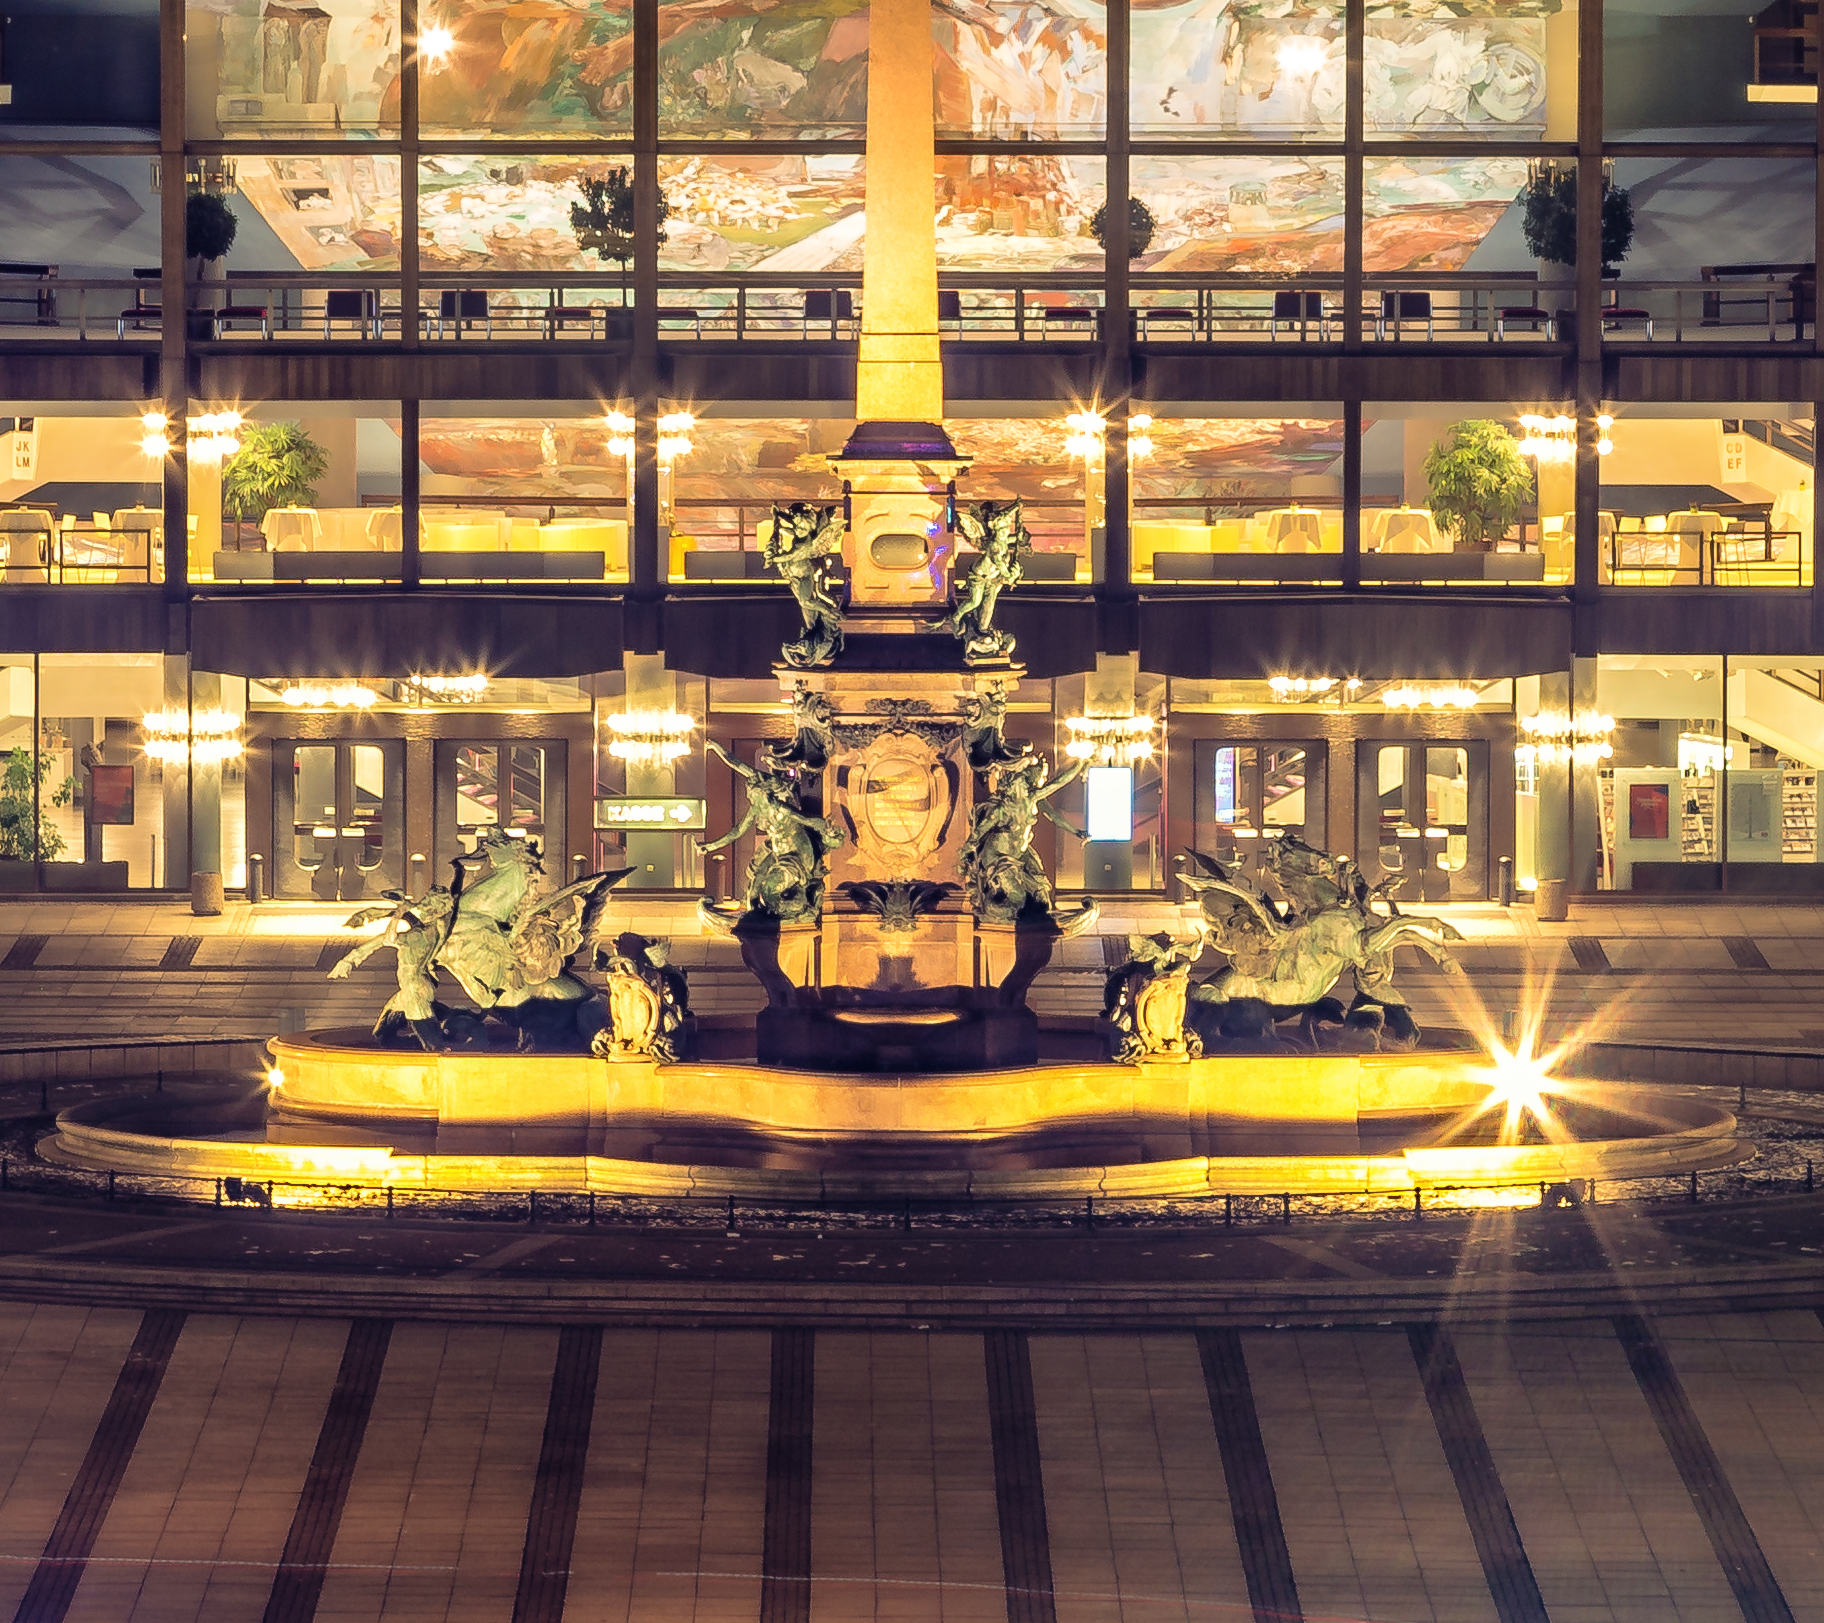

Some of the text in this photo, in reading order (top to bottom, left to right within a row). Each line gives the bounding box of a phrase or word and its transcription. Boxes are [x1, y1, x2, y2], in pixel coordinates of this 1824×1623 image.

[15, 440, 30, 453] JK
[1725, 442, 1743, 454] CD
[15, 455, 31, 468] LM
[1727, 457, 1743, 470] EF
